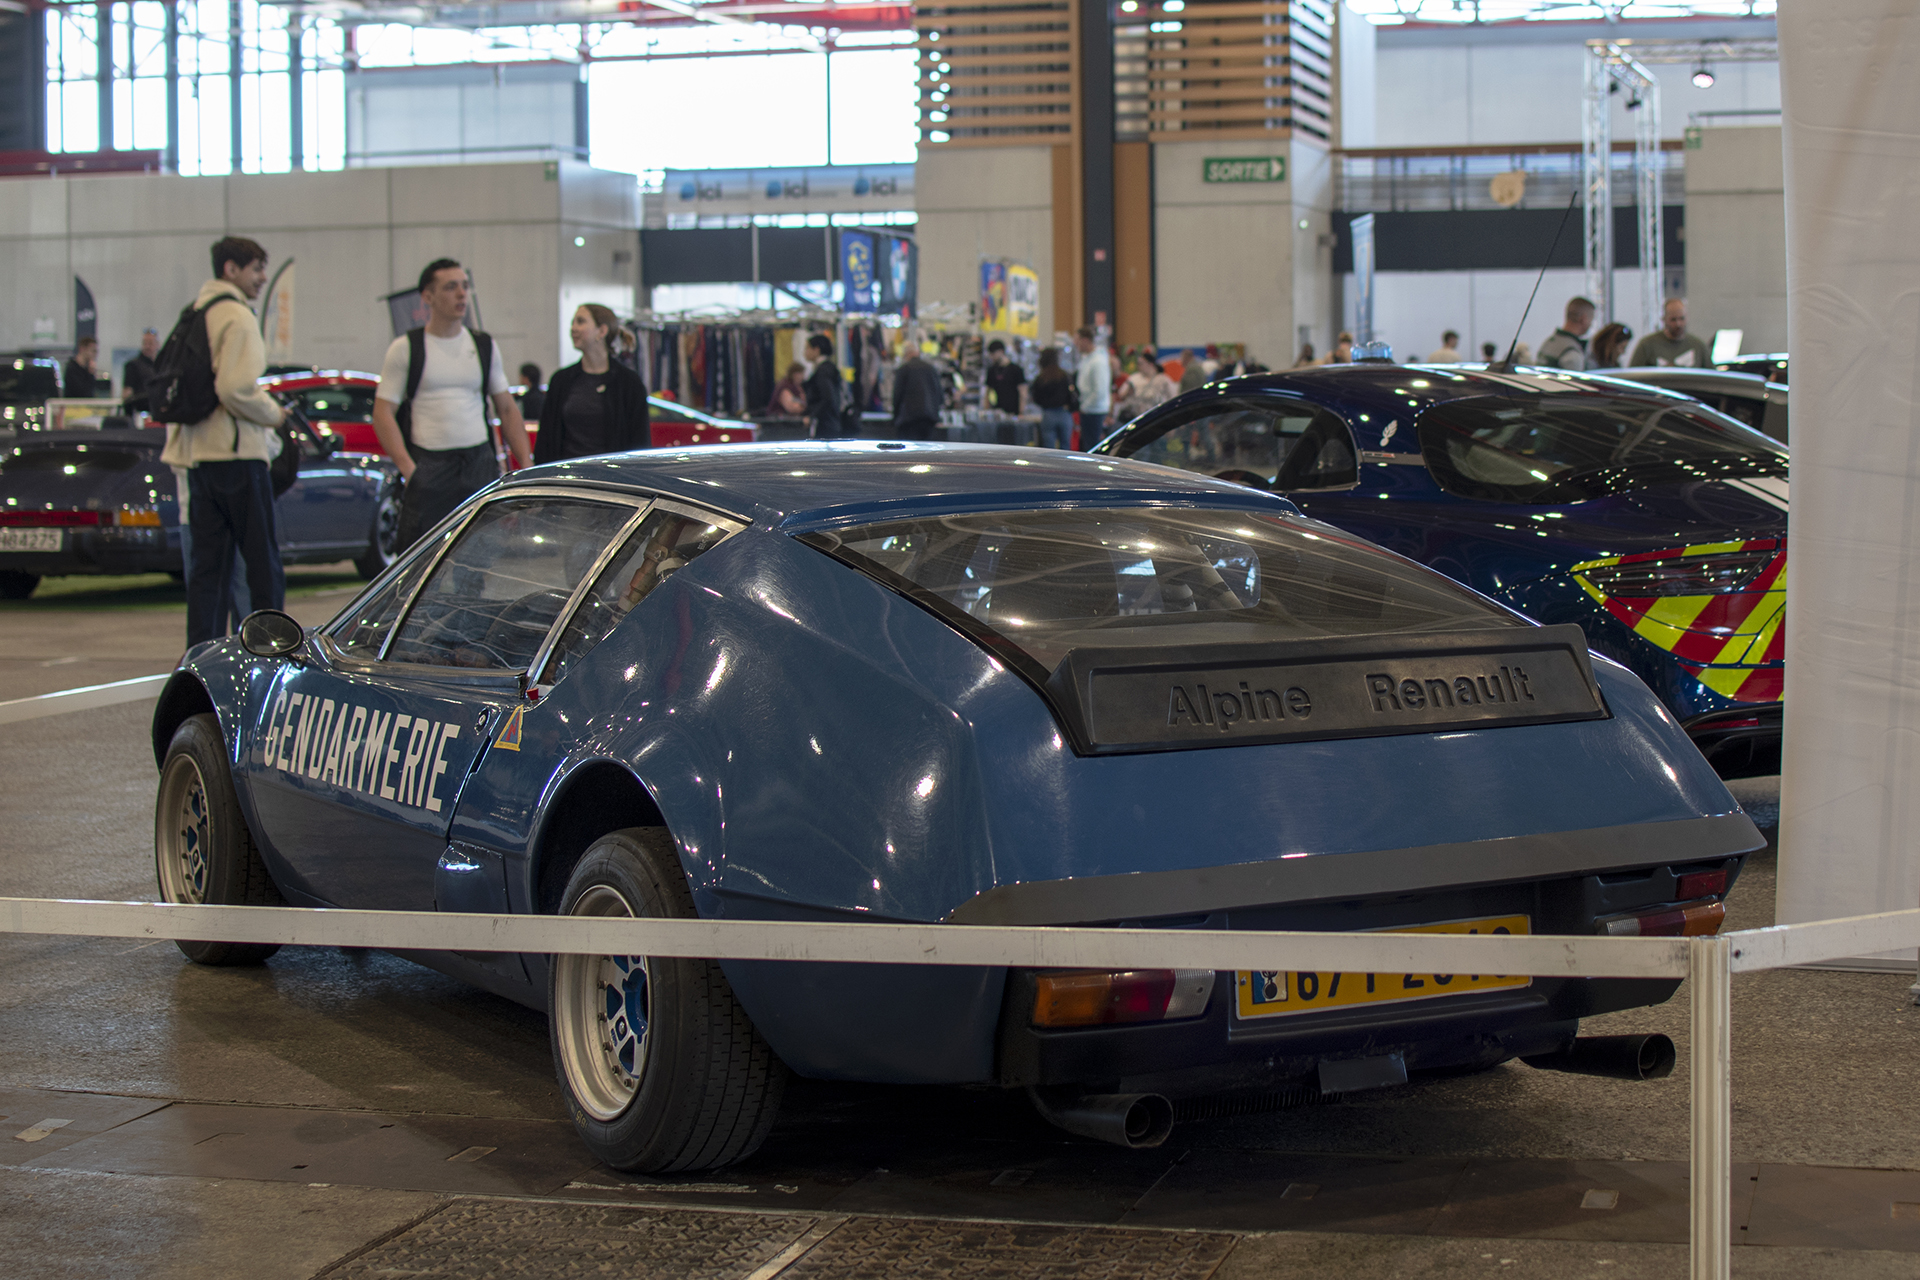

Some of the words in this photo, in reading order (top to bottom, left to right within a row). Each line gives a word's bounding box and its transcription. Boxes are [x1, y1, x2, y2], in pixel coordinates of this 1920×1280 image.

[1208, 162, 1268, 181] SORTIE
[1167, 681, 1312, 734] Alpine
[1364, 665, 1535, 712] Renault
[263, 689, 462, 813] GENDARMERIE
